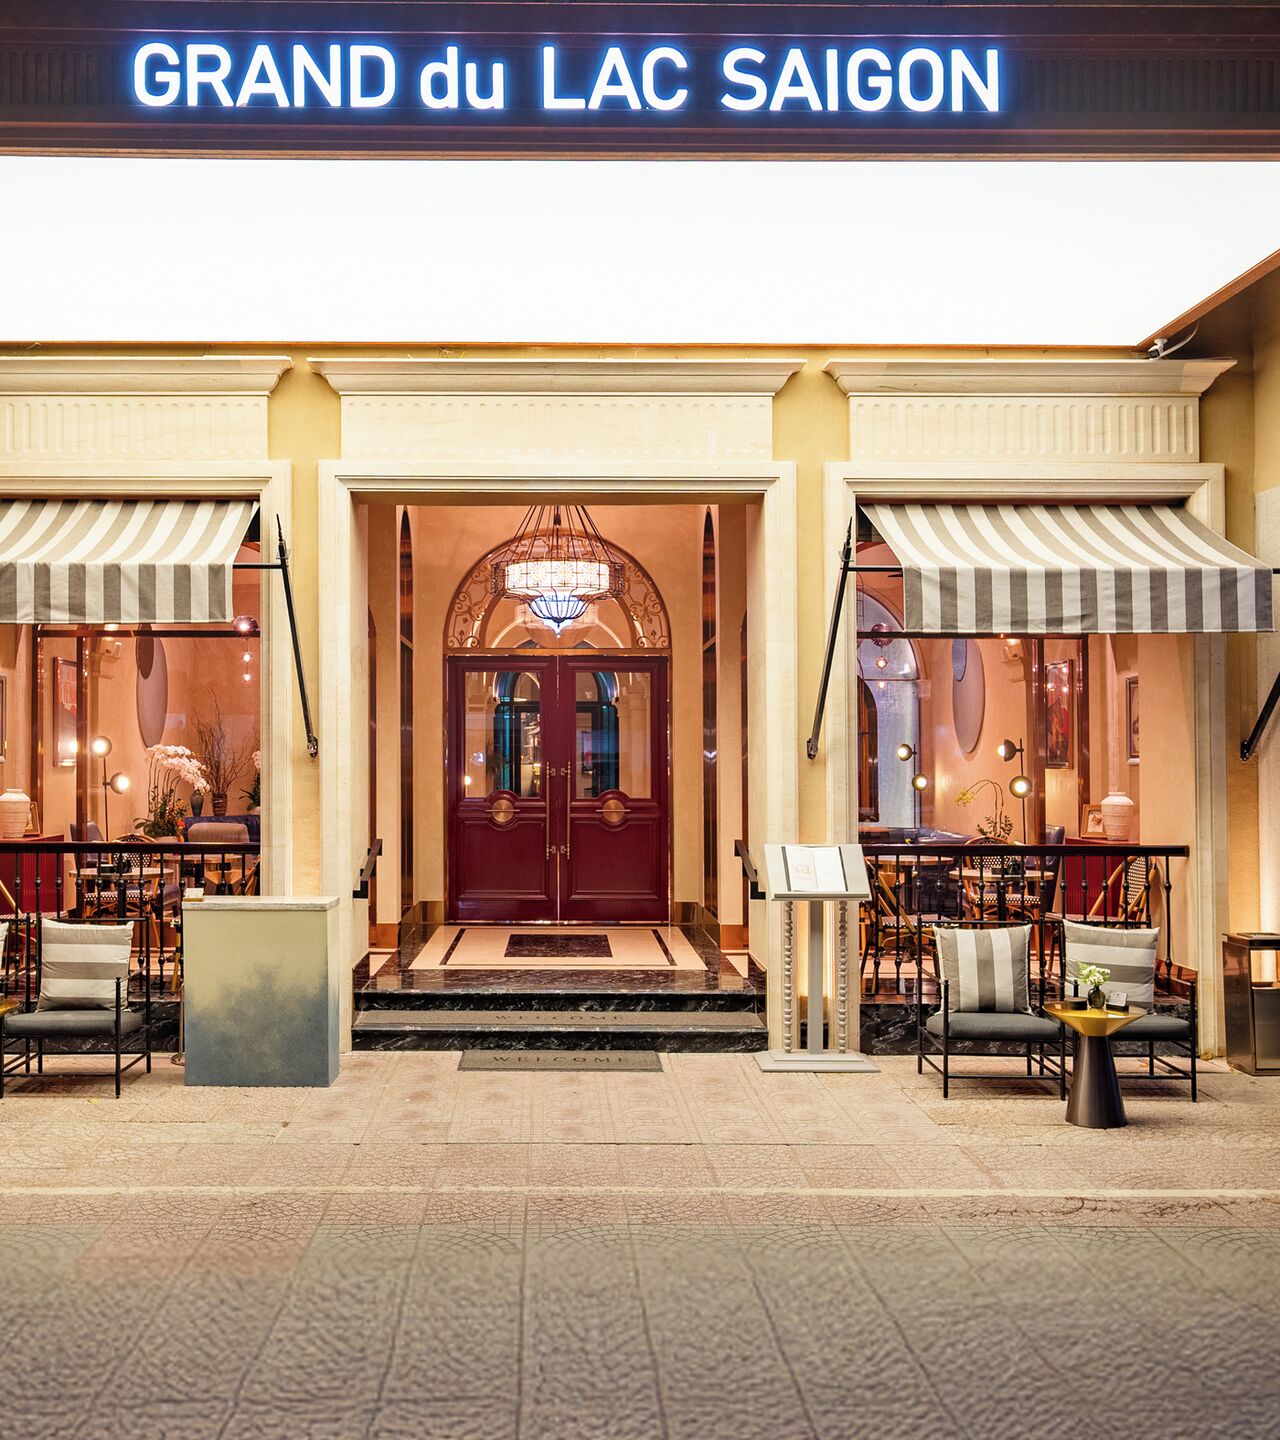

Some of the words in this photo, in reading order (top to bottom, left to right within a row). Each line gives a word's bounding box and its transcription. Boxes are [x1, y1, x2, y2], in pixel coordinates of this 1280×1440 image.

[133, 42, 396, 108] GRAND
[419, 45, 504, 110] du
[542, 45, 688, 111] LAC
[720, 47, 999, 112] SAIGON
[492, 1055, 629, 1064] WELCOME
